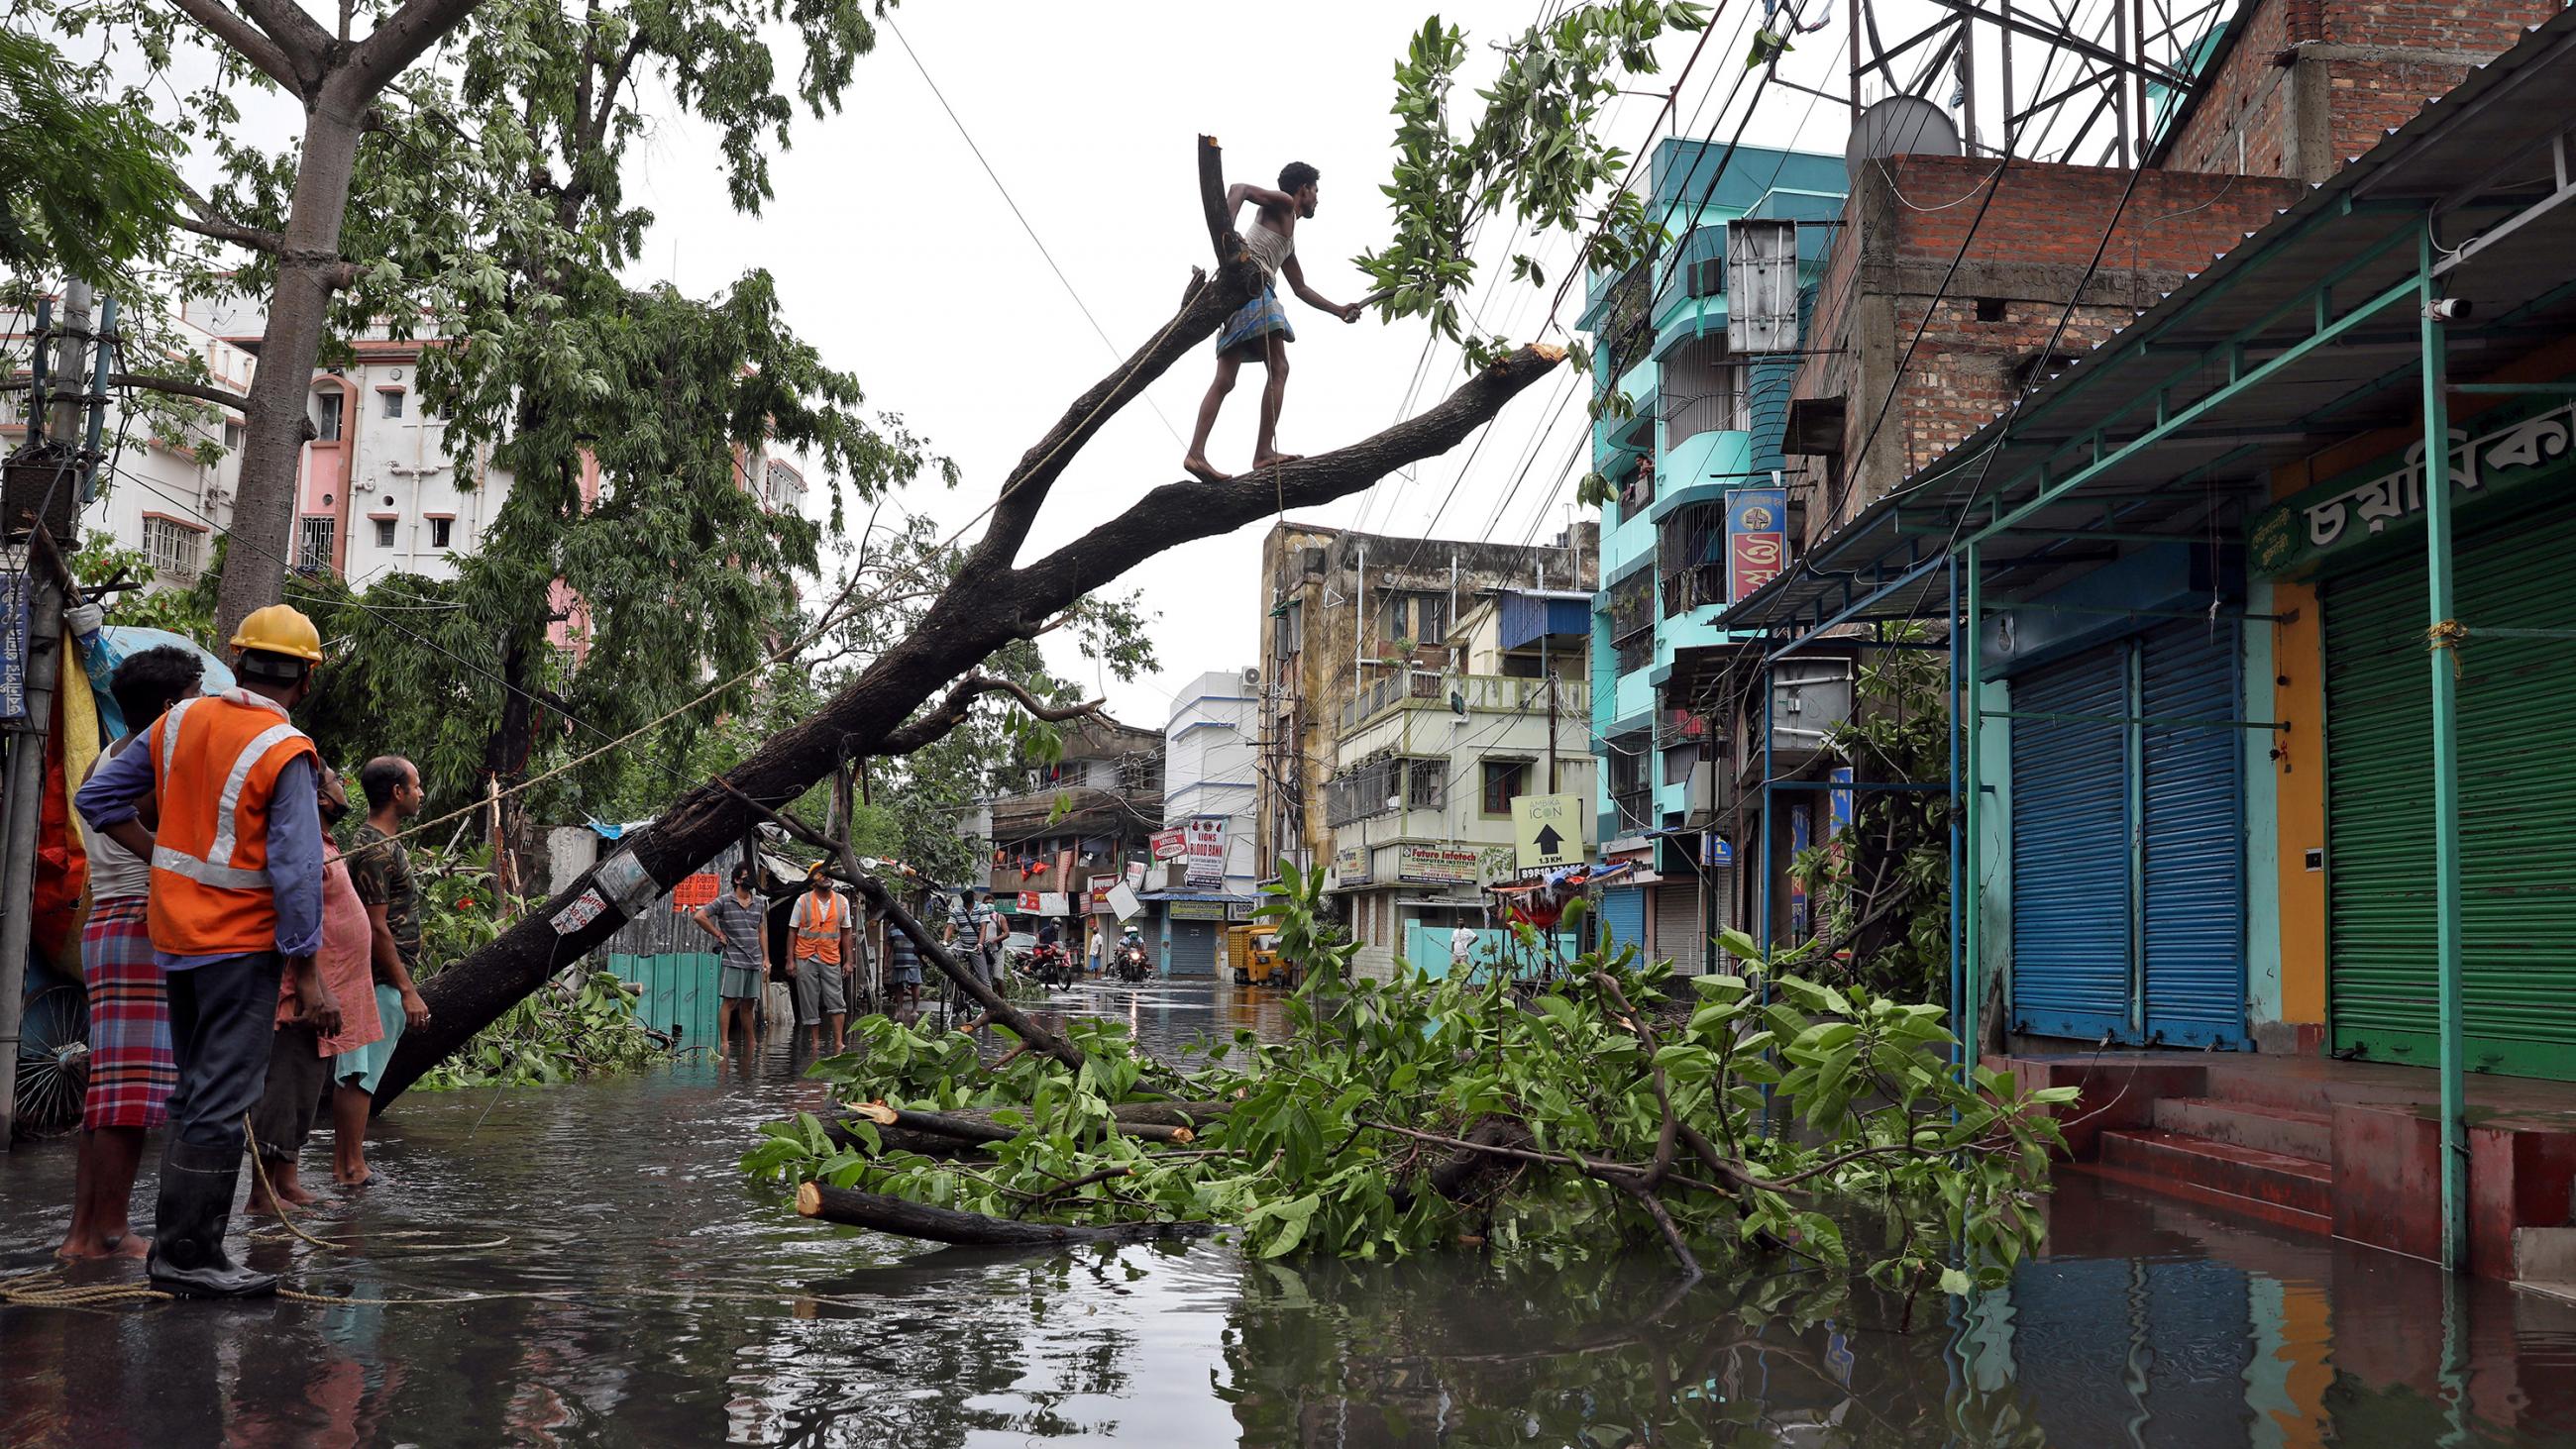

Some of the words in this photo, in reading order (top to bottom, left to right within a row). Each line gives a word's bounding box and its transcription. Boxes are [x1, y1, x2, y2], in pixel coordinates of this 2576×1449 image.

[1529, 798, 1561, 808] AMBIKA
[1529, 806, 1562, 819] ICON
[1198, 832, 1217, 842] LIONS
[1190, 843, 1208, 857] BLOOD
[1208, 844, 1223, 858] BANK
[1412, 848, 1440, 859] Future
[1442, 851, 1476, 861] Infotech
